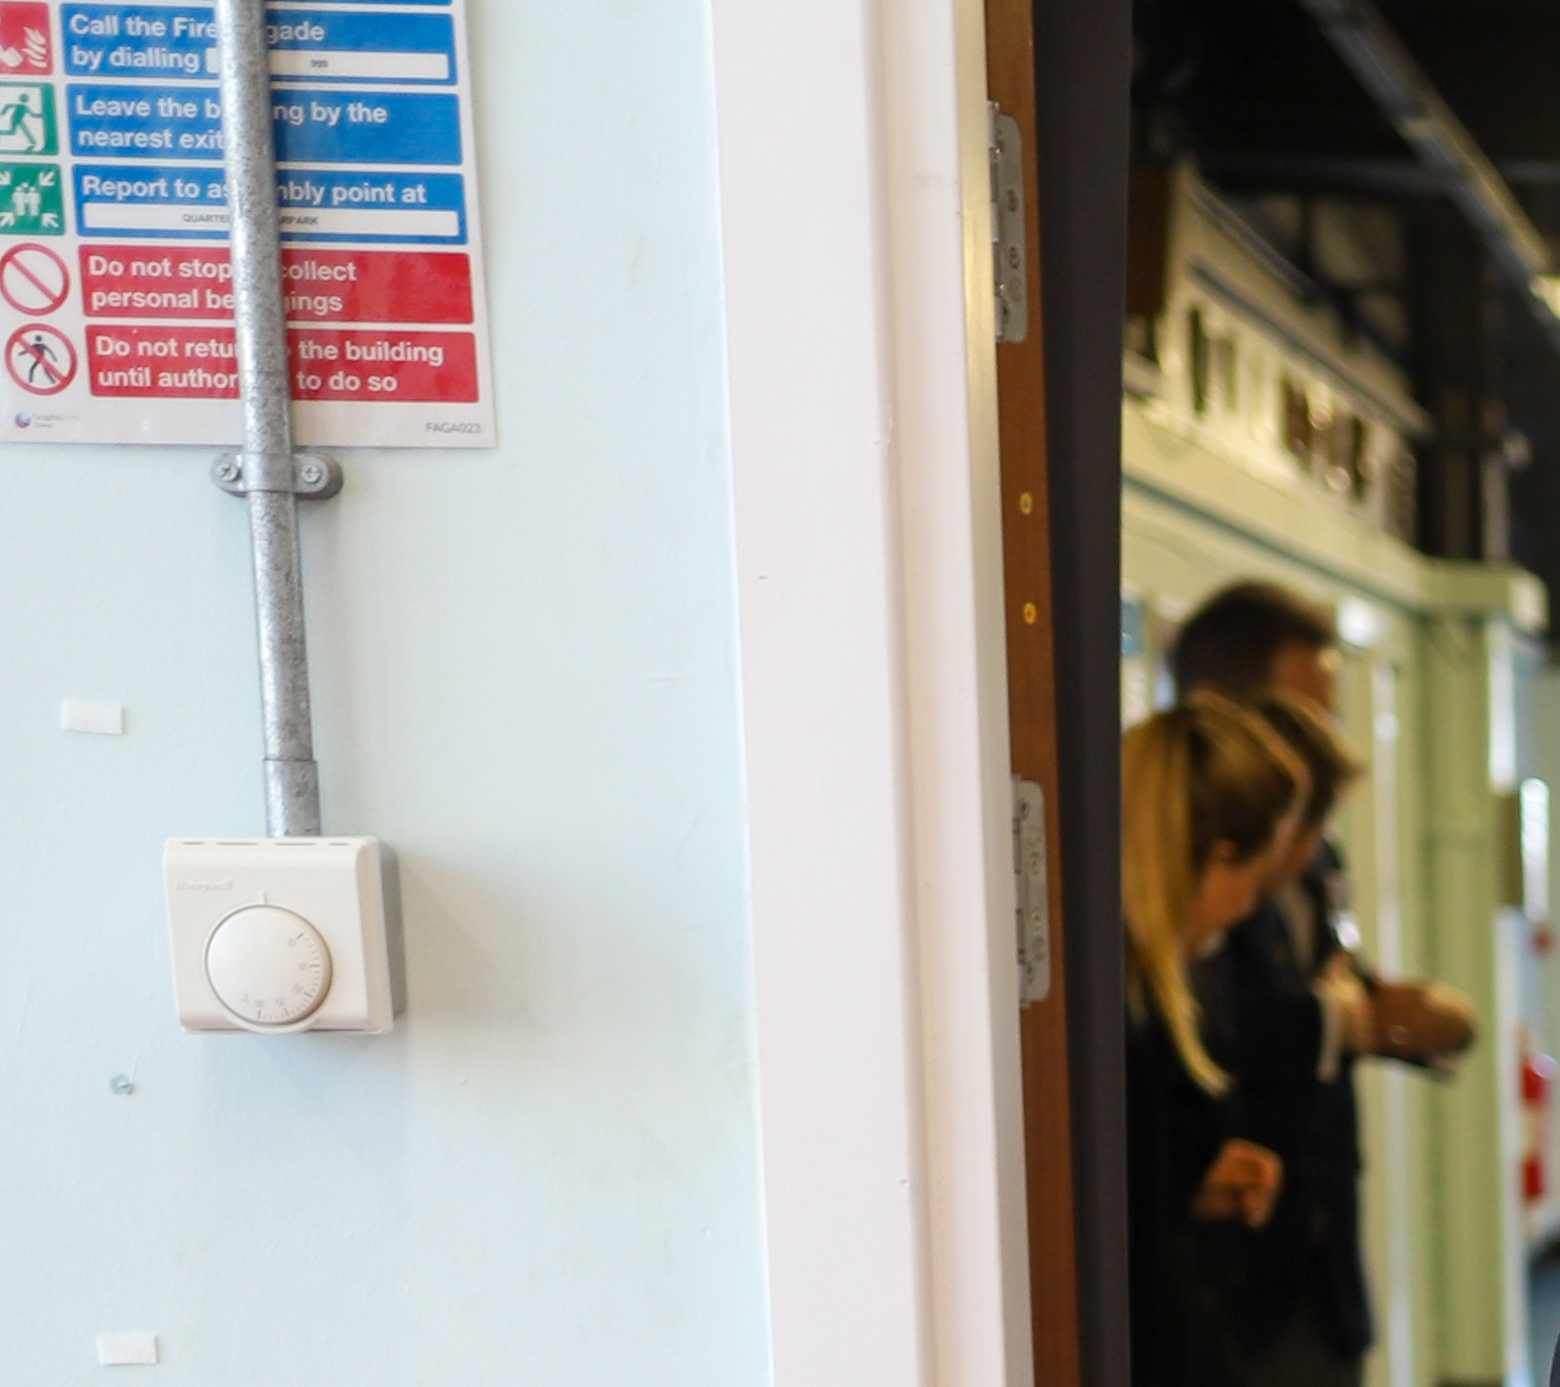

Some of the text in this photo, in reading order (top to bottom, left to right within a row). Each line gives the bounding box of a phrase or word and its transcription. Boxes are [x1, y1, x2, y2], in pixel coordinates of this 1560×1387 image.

[70, 14, 119, 35] Call
[125, 16, 166, 36] the
[173, 17, 217, 37] Fire
[72, 46, 103, 70] by
[109, 47, 199, 73] dialling
[76, 95, 151, 116] Leave
[157, 97, 198, 118] the
[311, 102, 340, 126] by
[347, 102, 388, 124] the
[79, 128, 225, 149] nearest exit
[82, 175, 168, 200] Report
[174, 178, 200, 198] to
[332, 183, 395, 205] point
[401, 184, 427, 203] at
[89, 256, 124, 276] Do
[131, 257, 172, 277] not
[179, 258, 233, 282] stop
[92, 288, 199, 311] personal
[95, 336, 444, 367] Do not retu the building
[99, 367, 398, 392] until author to do so
